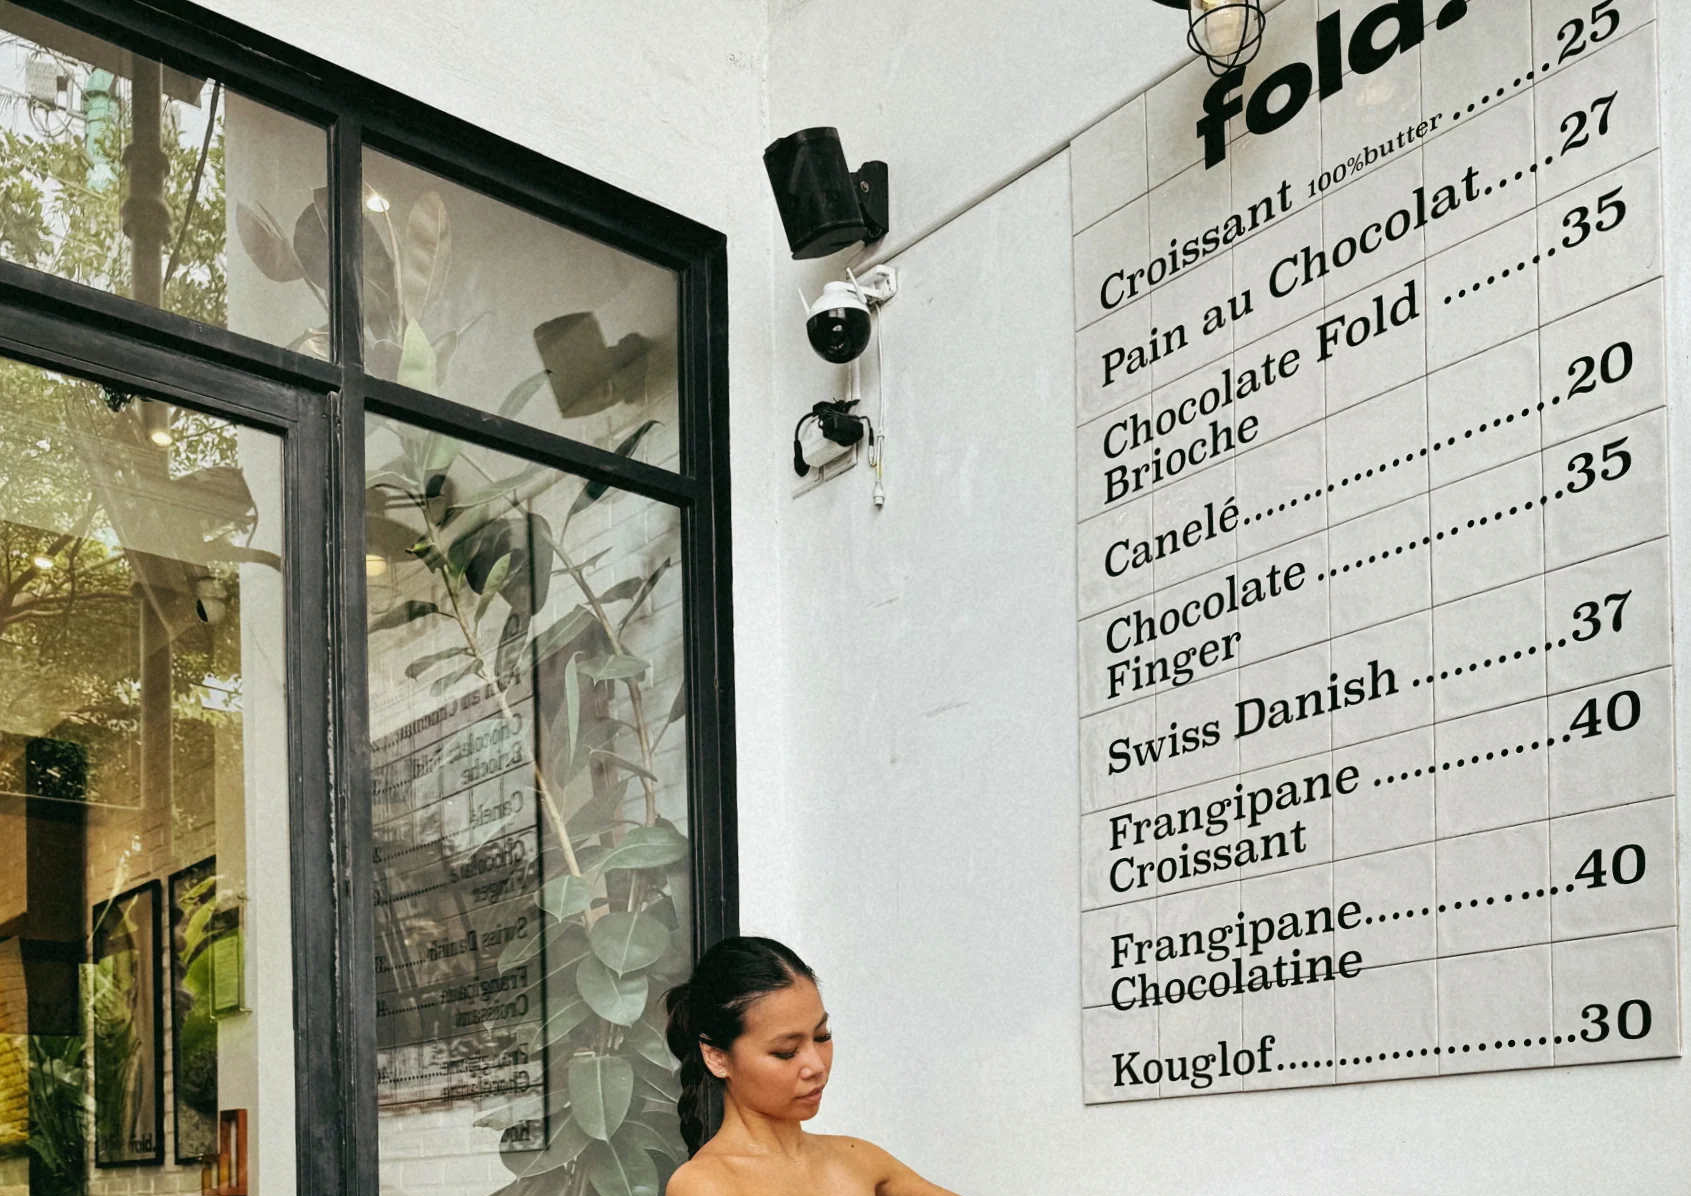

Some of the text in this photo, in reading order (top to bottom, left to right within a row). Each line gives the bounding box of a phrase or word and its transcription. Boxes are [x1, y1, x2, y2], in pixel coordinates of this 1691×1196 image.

[1100, 1, 1620, 310] Croissant 100%butter 25
[1196, 0, 1468, 170] fold.
[1101, 90, 1618, 388] Pain au Chocolat 27
[1103, 185, 1626, 459] Chocolate Fold 35
[1104, 341, 1633, 578] Canelé 20
[1104, 415, 1259, 505] Brioche
[1106, 436, 1632, 654] Chocolate 35
[1106, 631, 1242, 700] Finger
[1108, 589, 1633, 776] Swiss Danish 37
[1109, 690, 1641, 851] Frangipane 40
[1109, 820, 1307, 893] Croissant
[1110, 843, 1646, 969] Frangipane 40
[1110, 949, 1363, 1011] Chocolatine
[1111, 999, 1652, 1089] Kouglof 30
